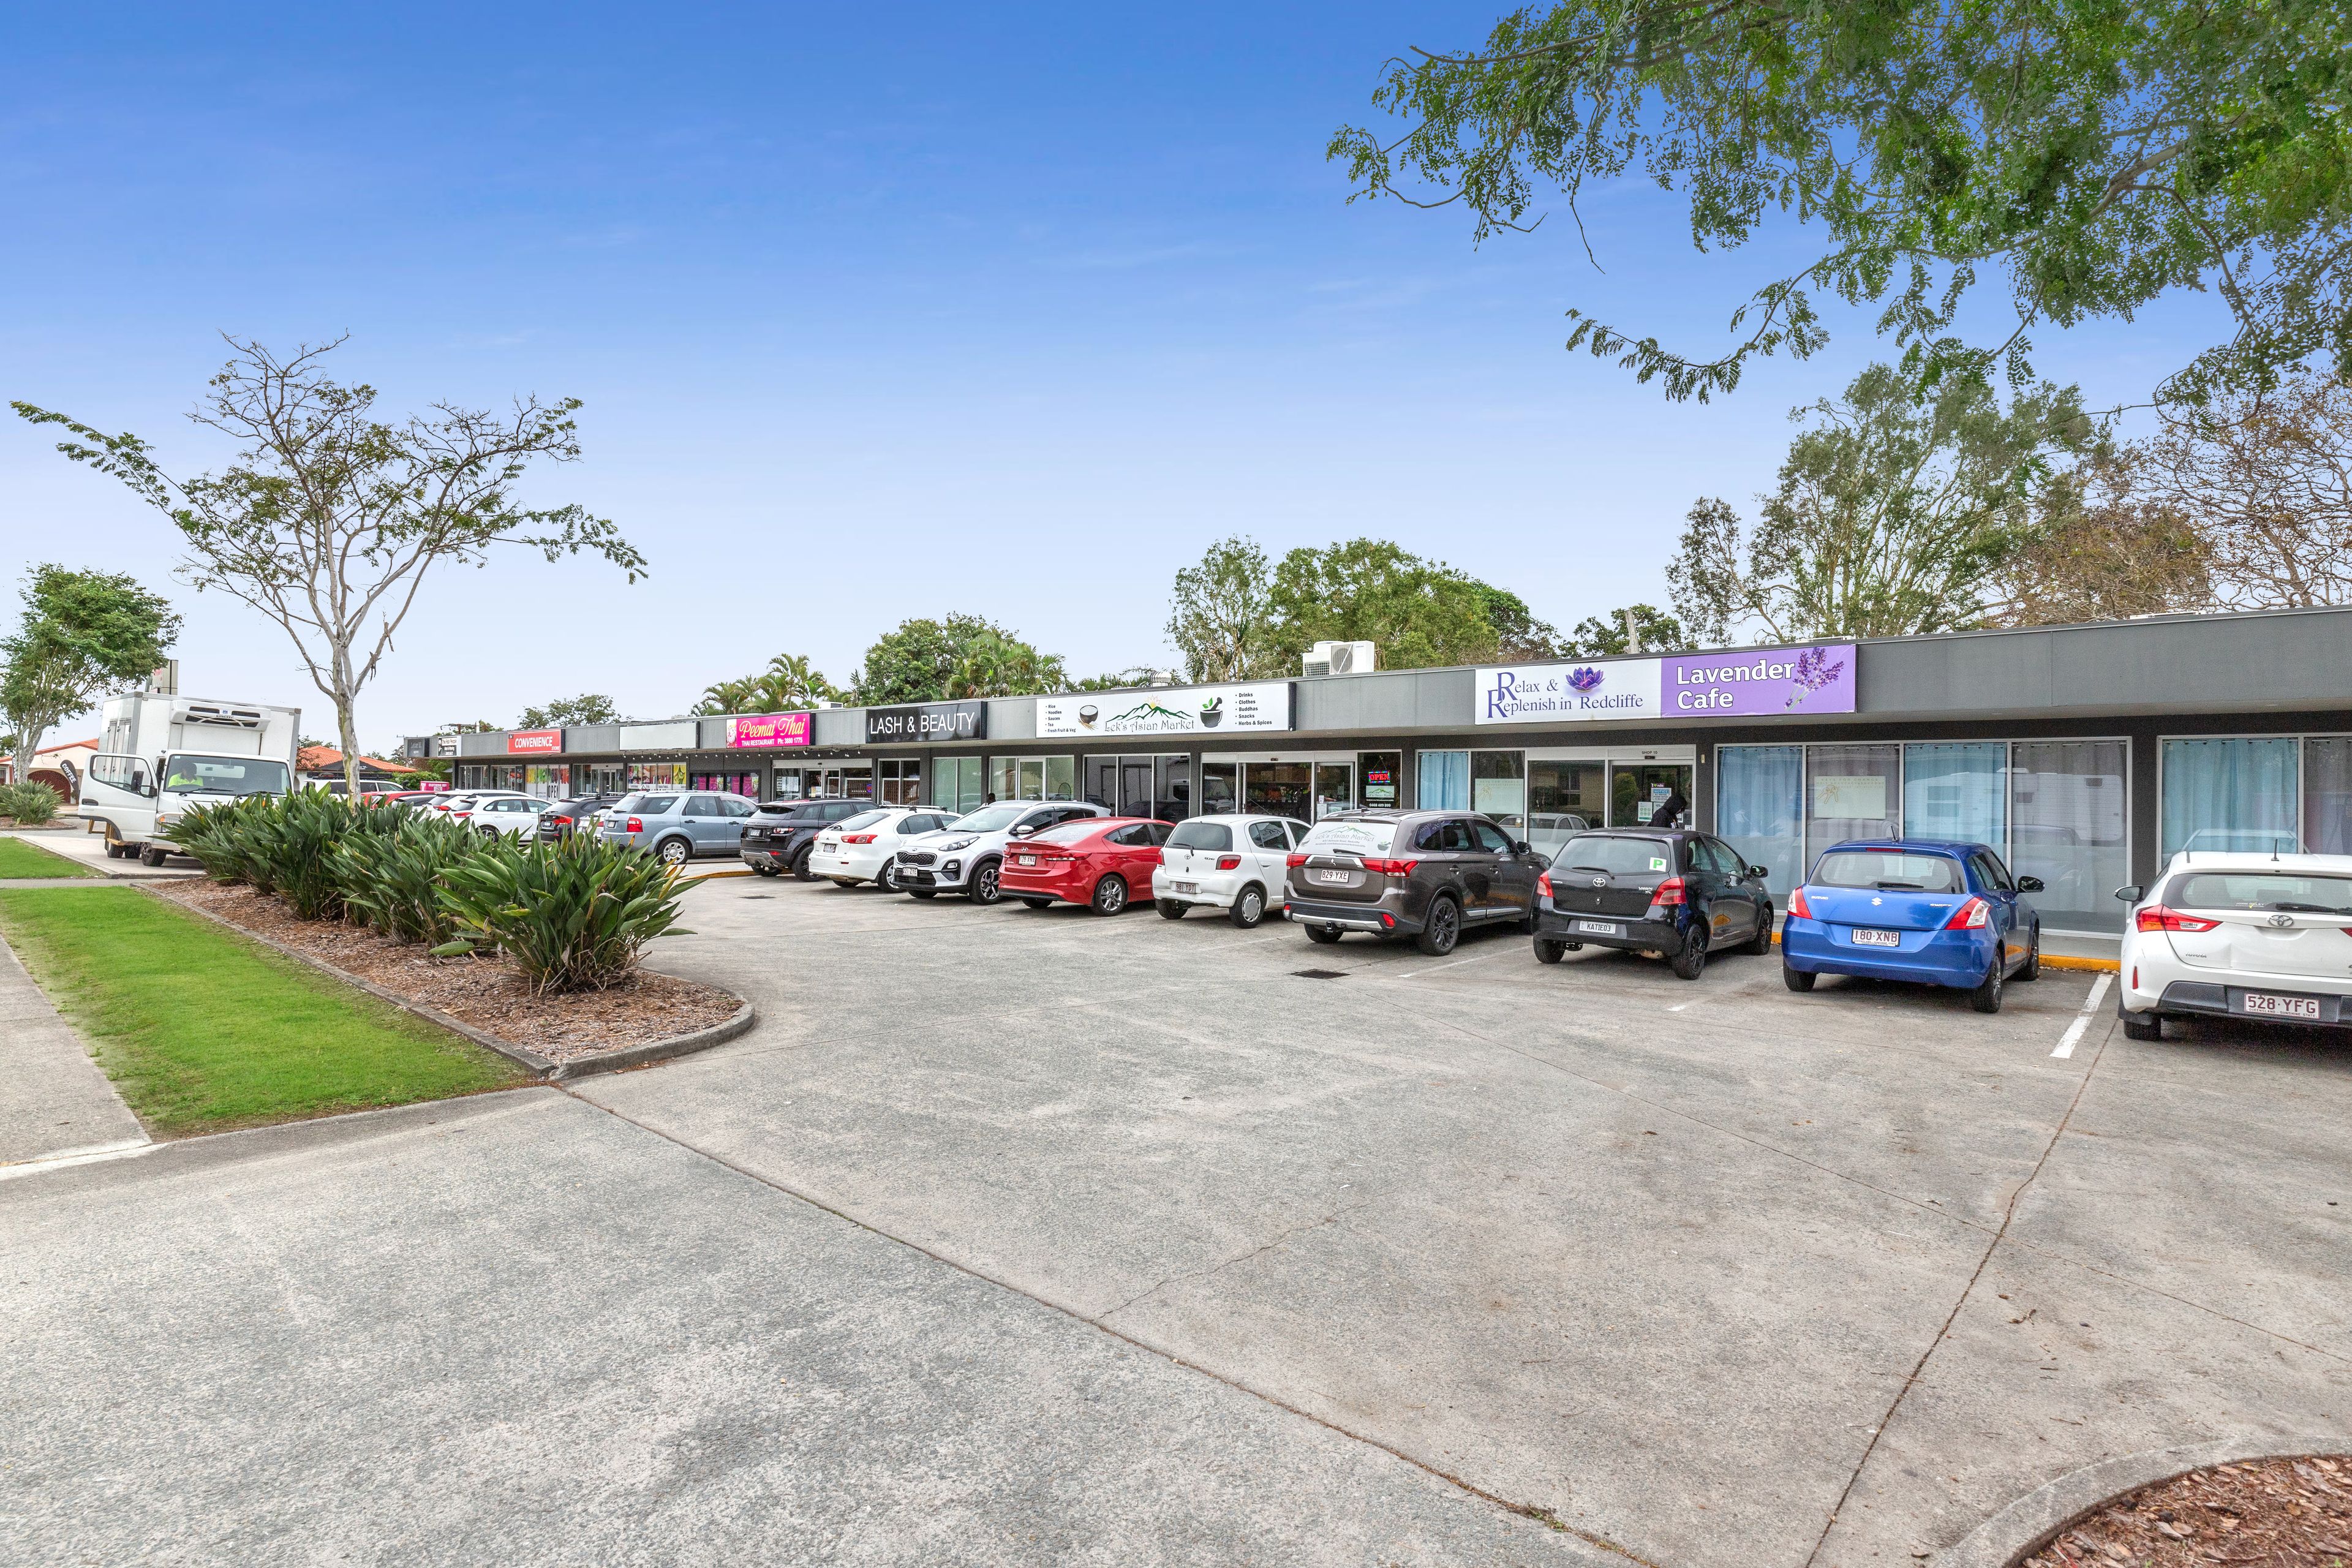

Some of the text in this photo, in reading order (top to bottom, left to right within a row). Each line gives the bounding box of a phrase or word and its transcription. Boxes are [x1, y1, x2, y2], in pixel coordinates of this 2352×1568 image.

[1677, 659, 1795, 685] Lavender
[1497, 672, 1559, 701] Relax &
[1487, 690, 1643, 718] Replenish in Redcliffe
[1677, 687, 1733, 709] Cafe
[739, 715, 806, 738] Peemai Thai
[870, 712, 975, 734] LASH & BEAUTY
[1105, 720, 1194, 733] Lek's Asian Market
[514, 736, 553, 748] CONVENIENCE
[61, 763, 76, 784] COFFEE
[1350, 834, 1375, 842] Market
[1653, 859, 1663, 869] P
[1586, 921, 1611, 932] KATIE03
